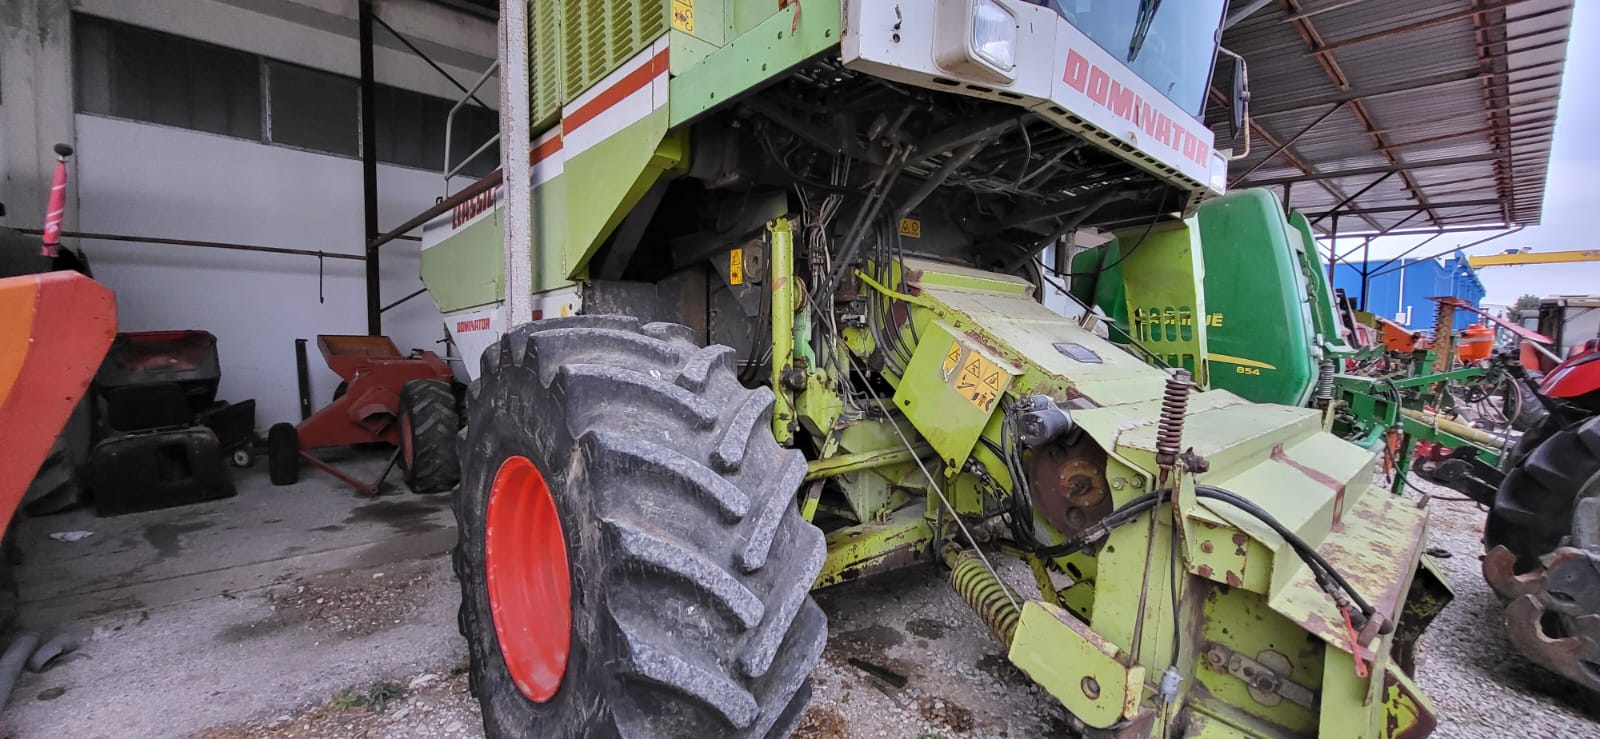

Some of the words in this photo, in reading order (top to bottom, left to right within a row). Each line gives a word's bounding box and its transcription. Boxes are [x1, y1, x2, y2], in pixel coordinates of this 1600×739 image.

[1063, 48, 1209, 168] DOMINATOR
[457, 317, 490, 333] DOMINATOR
[1236, 366, 1260, 376] 854
